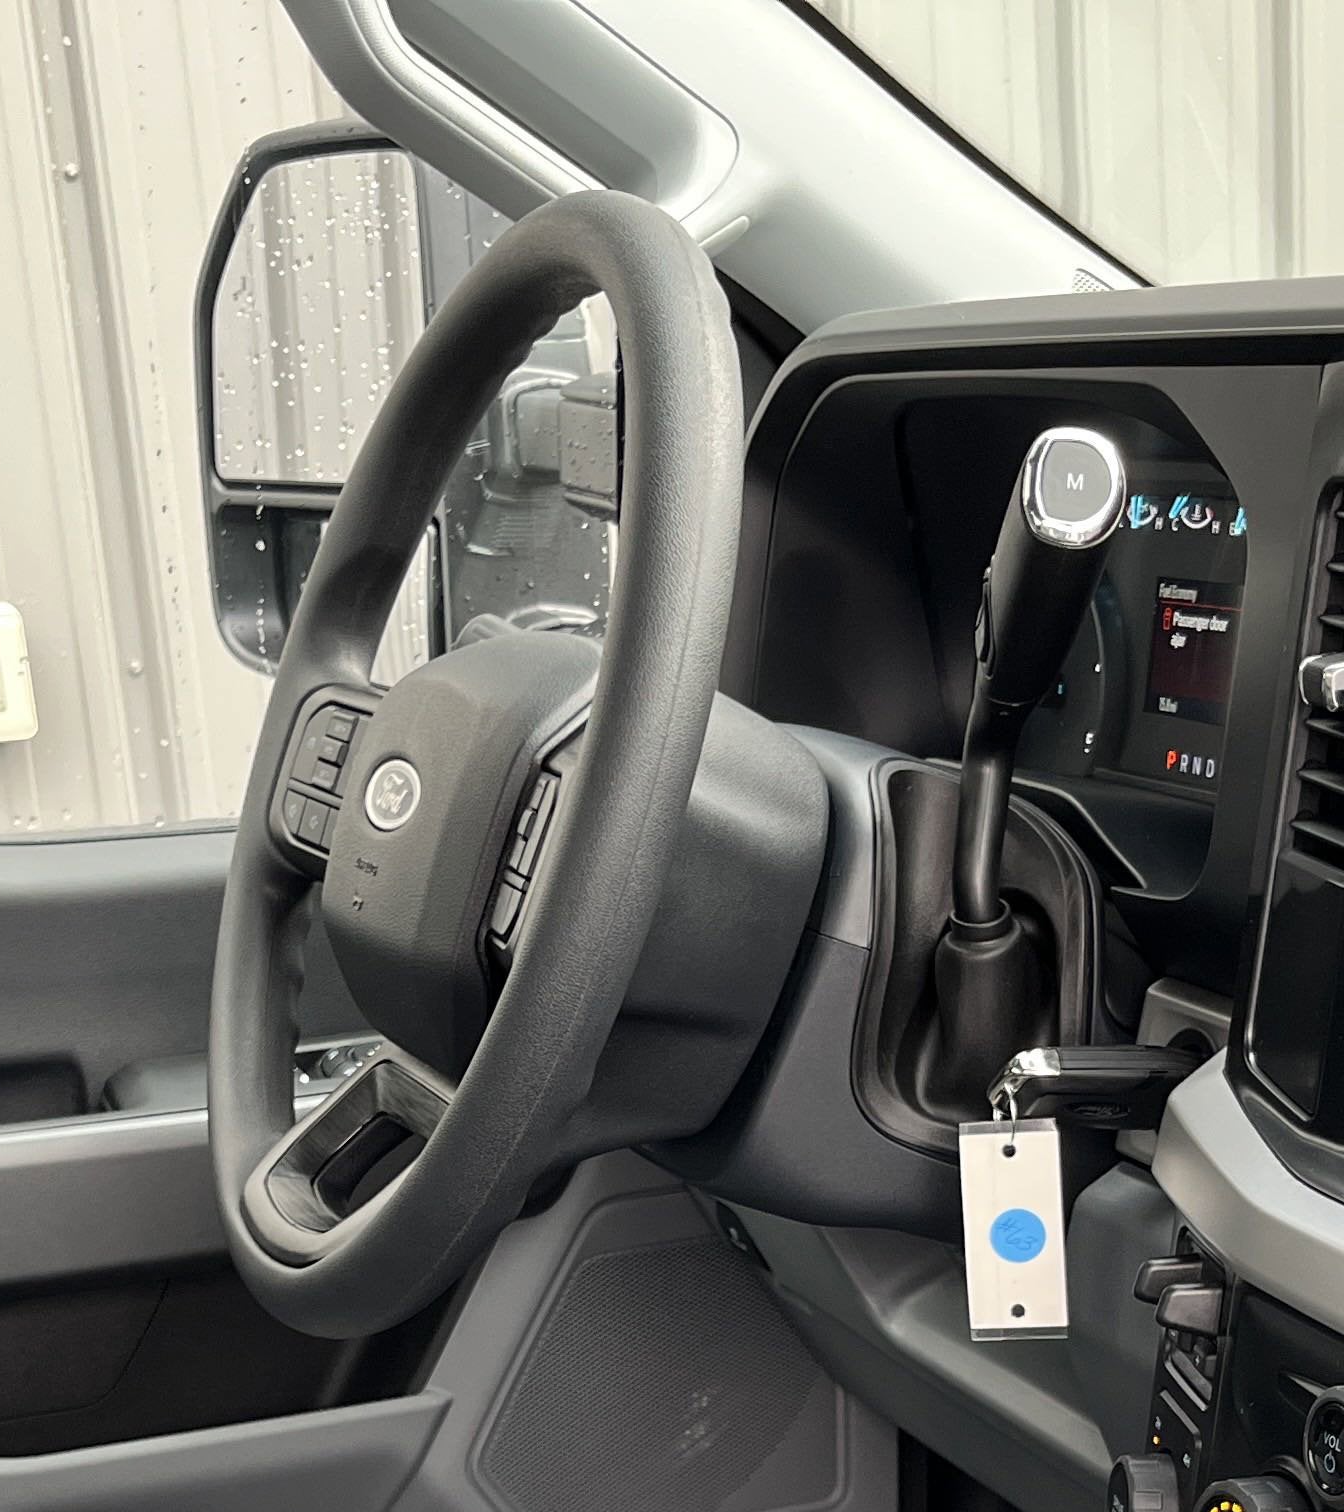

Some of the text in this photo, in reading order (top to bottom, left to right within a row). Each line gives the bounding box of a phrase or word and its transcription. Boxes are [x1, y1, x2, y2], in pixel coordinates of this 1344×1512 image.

[1067, 473, 1084, 490] M
[1167, 750, 1215, 778] P R N D
[1323, 1431, 1342, 1452] VOL
